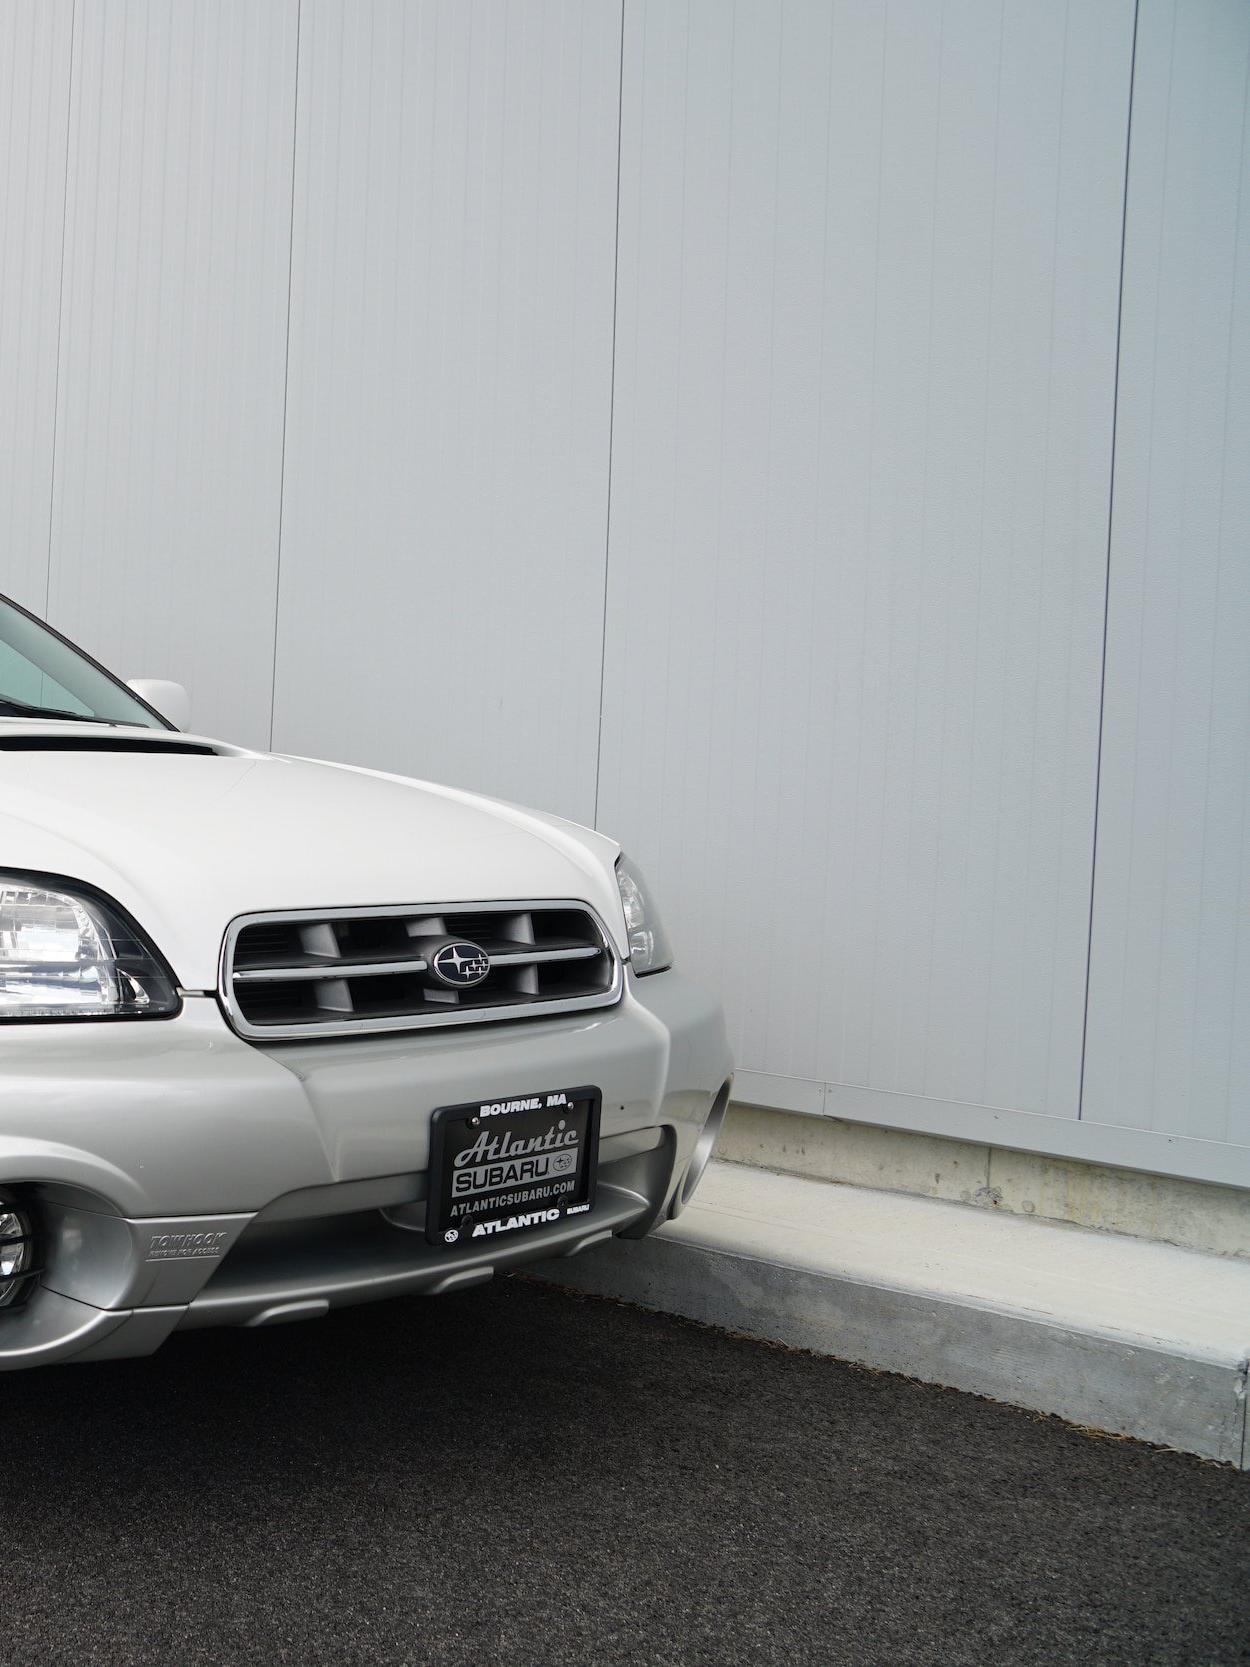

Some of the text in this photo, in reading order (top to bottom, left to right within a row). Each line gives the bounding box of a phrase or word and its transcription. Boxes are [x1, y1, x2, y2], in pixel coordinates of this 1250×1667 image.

[480, 1094, 567, 1117] BOURNE, MA
[454, 1120, 579, 1167] Atlantic
[455, 1157, 550, 1192] SUBARU
[450, 1181, 575, 1217] ATLANTICSUBARU.COM
[472, 1208, 560, 1237] ATLANTIC
